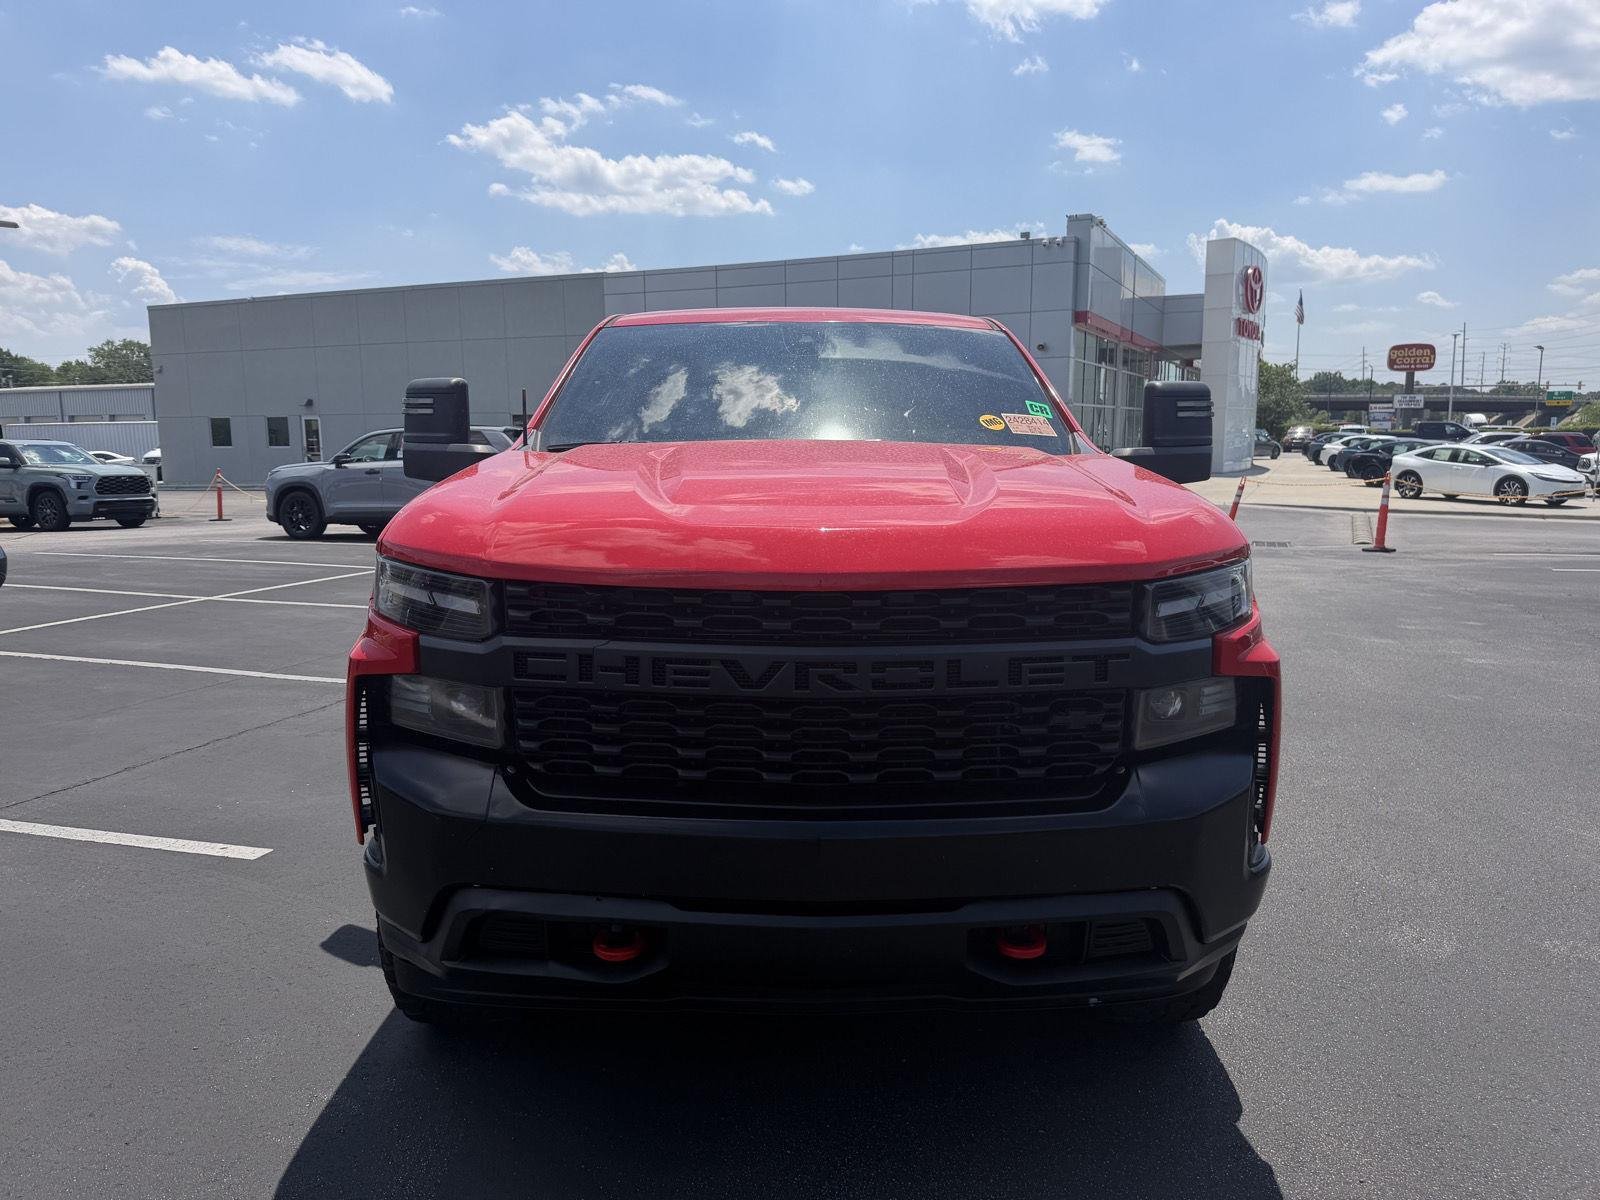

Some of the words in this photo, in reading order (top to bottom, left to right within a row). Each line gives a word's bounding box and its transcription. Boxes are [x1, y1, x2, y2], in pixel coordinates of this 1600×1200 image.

[1391, 348, 1430, 359] golden
[1396, 355, 1434, 364] corral
[982, 417, 1003, 427] IMG
[513, 651, 1131, 692] CHEVROLET
